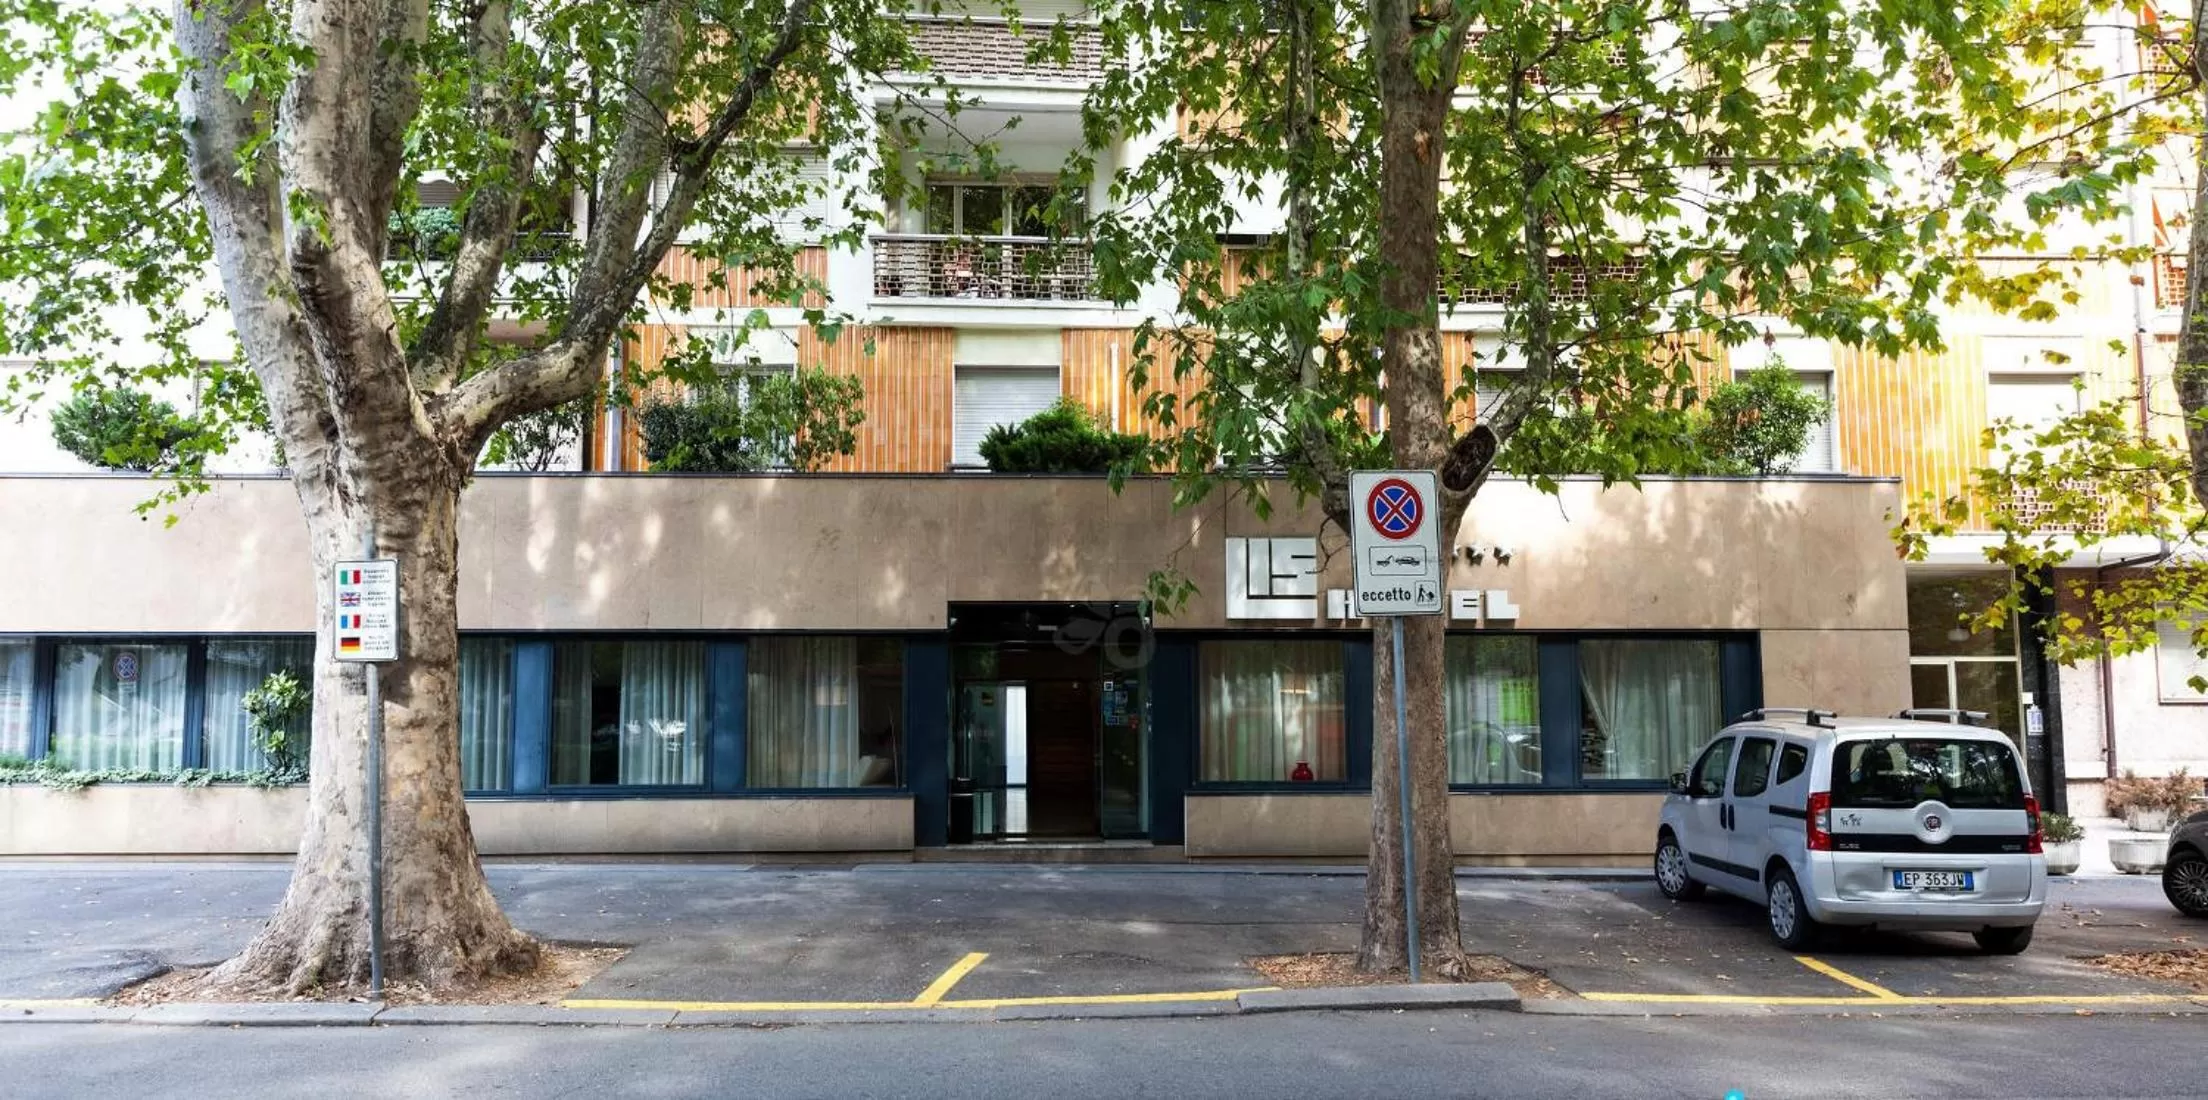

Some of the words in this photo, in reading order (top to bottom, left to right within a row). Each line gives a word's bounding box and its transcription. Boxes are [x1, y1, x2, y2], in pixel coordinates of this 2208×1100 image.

[1362, 587, 1411, 601] eccetto
[1327, 588, 1520, 619] HEL
[1904, 872, 1920, 886] EP
